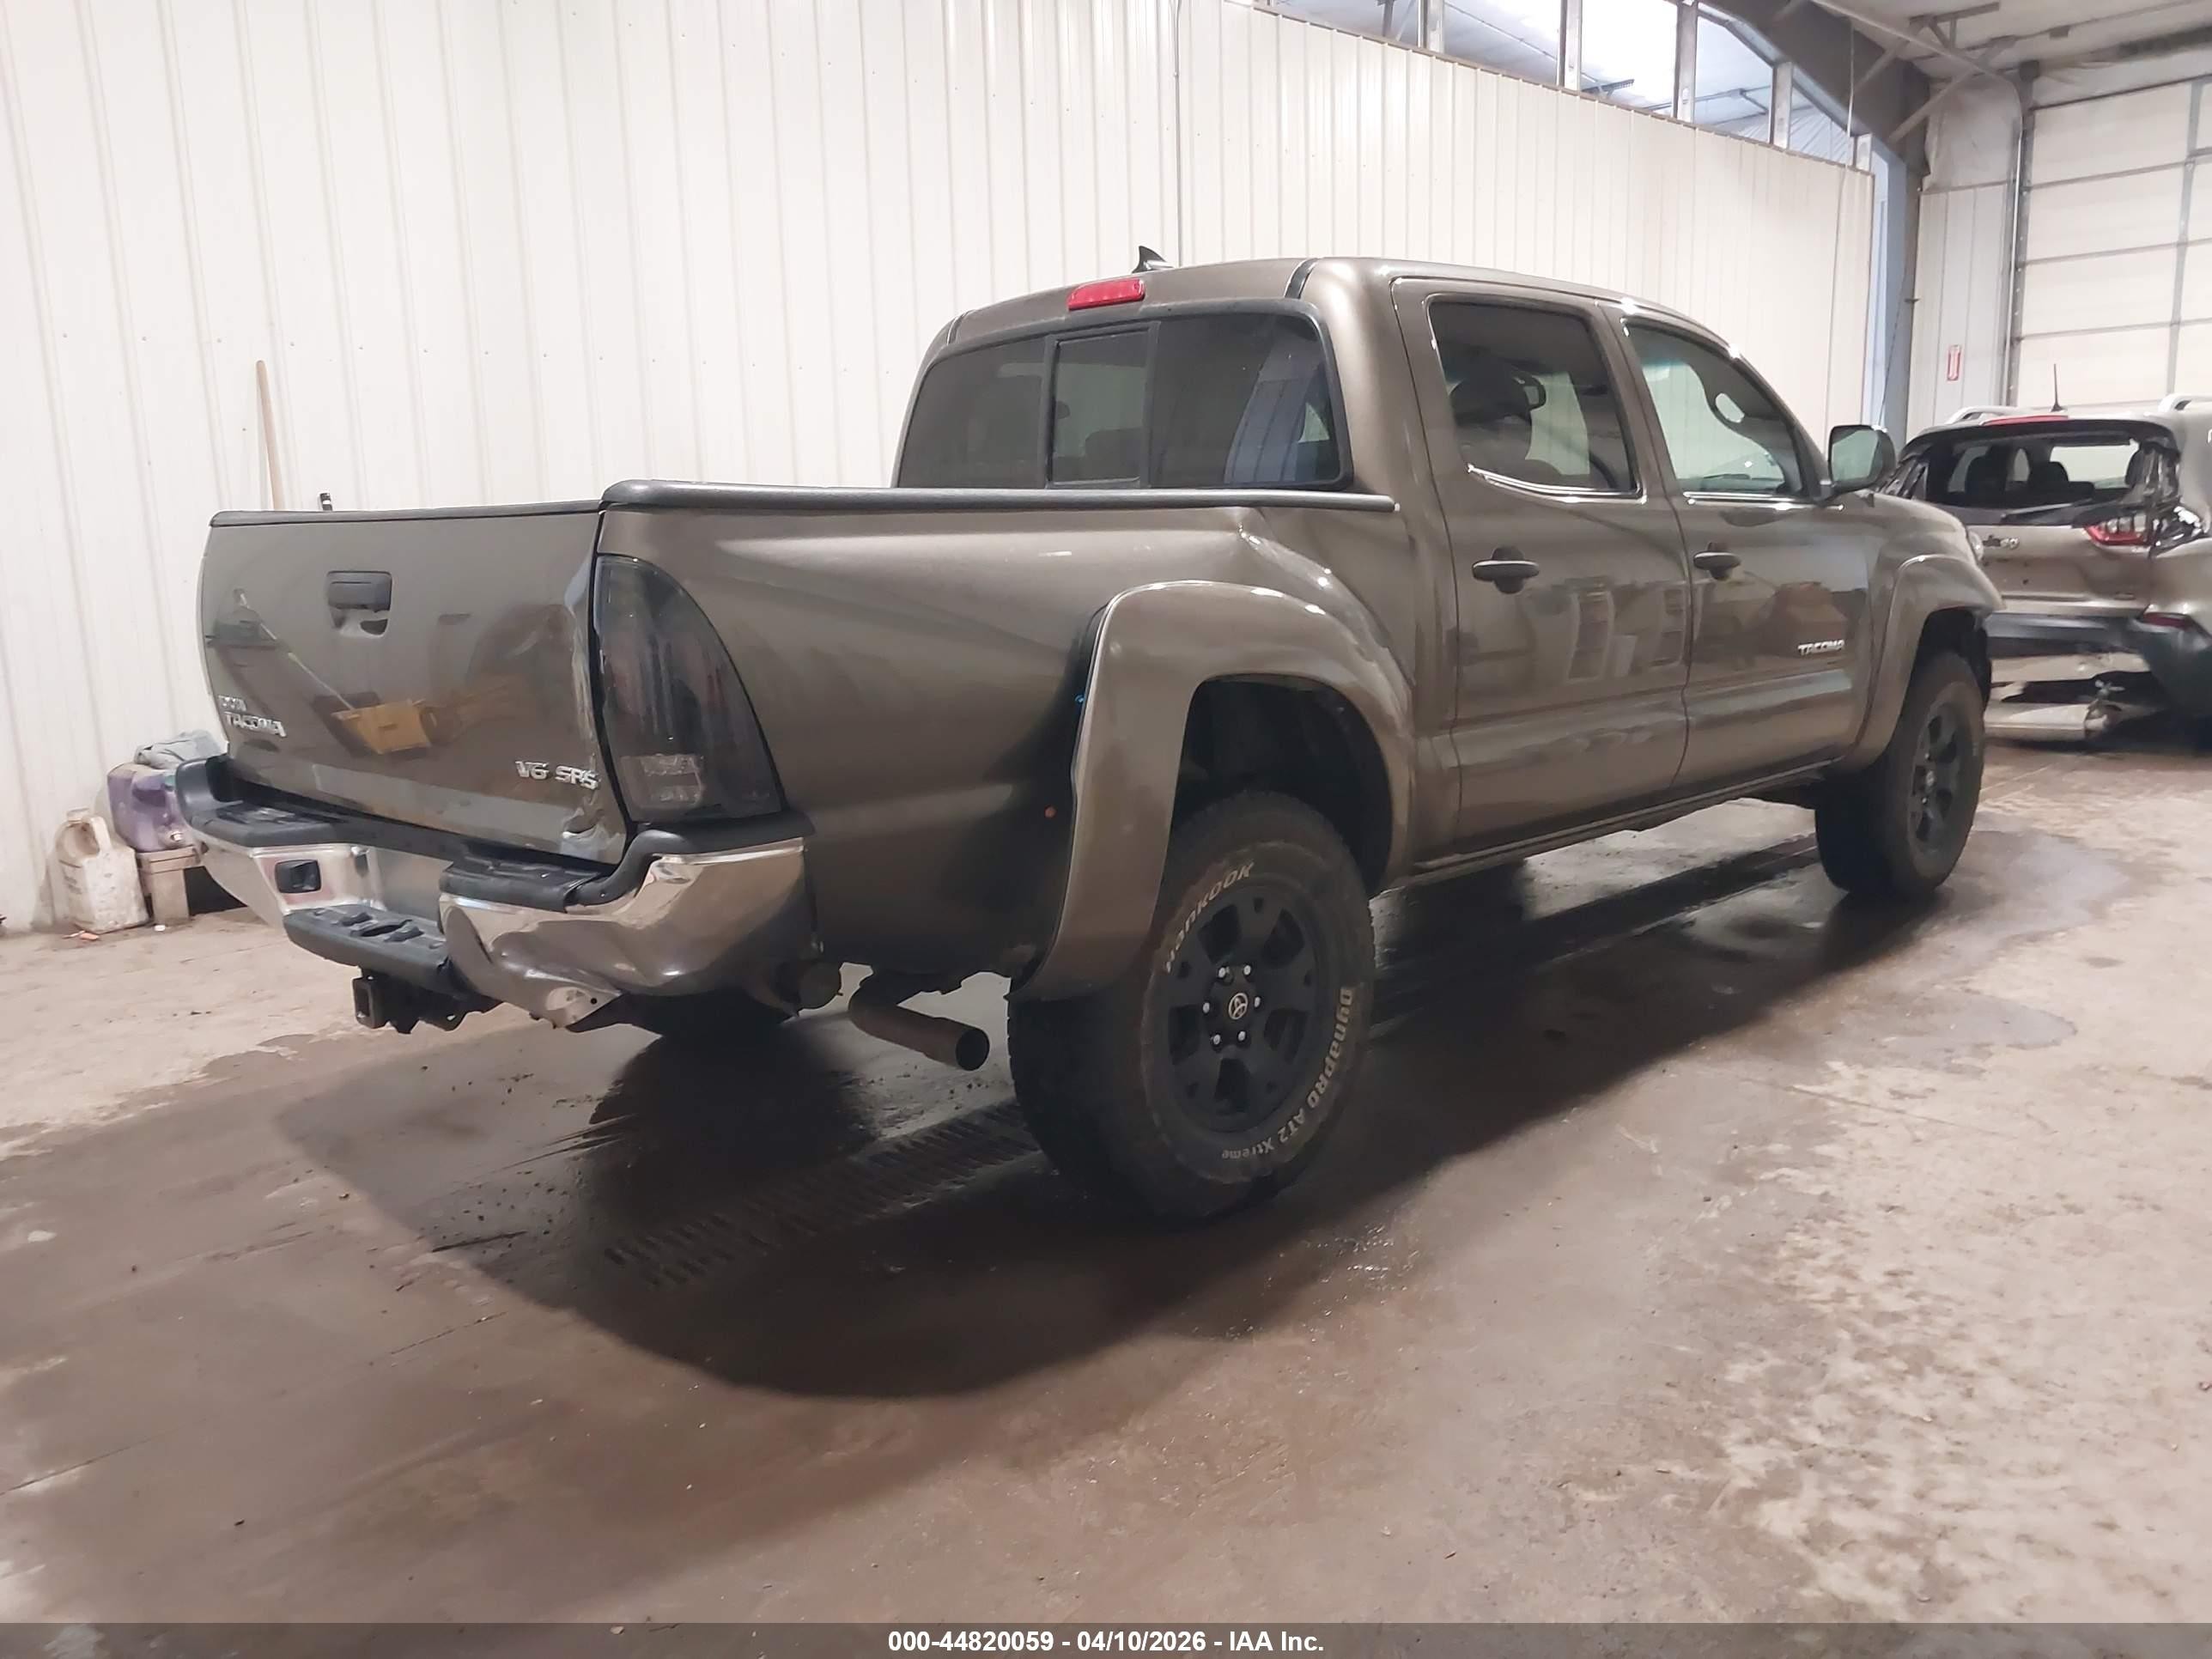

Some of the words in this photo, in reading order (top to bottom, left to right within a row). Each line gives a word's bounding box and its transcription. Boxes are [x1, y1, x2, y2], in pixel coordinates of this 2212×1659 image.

[514, 761, 550, 781] V6
[1277, 1107, 1306, 1143] AT2
[1221, 1136, 1276, 1158] Xtreme
